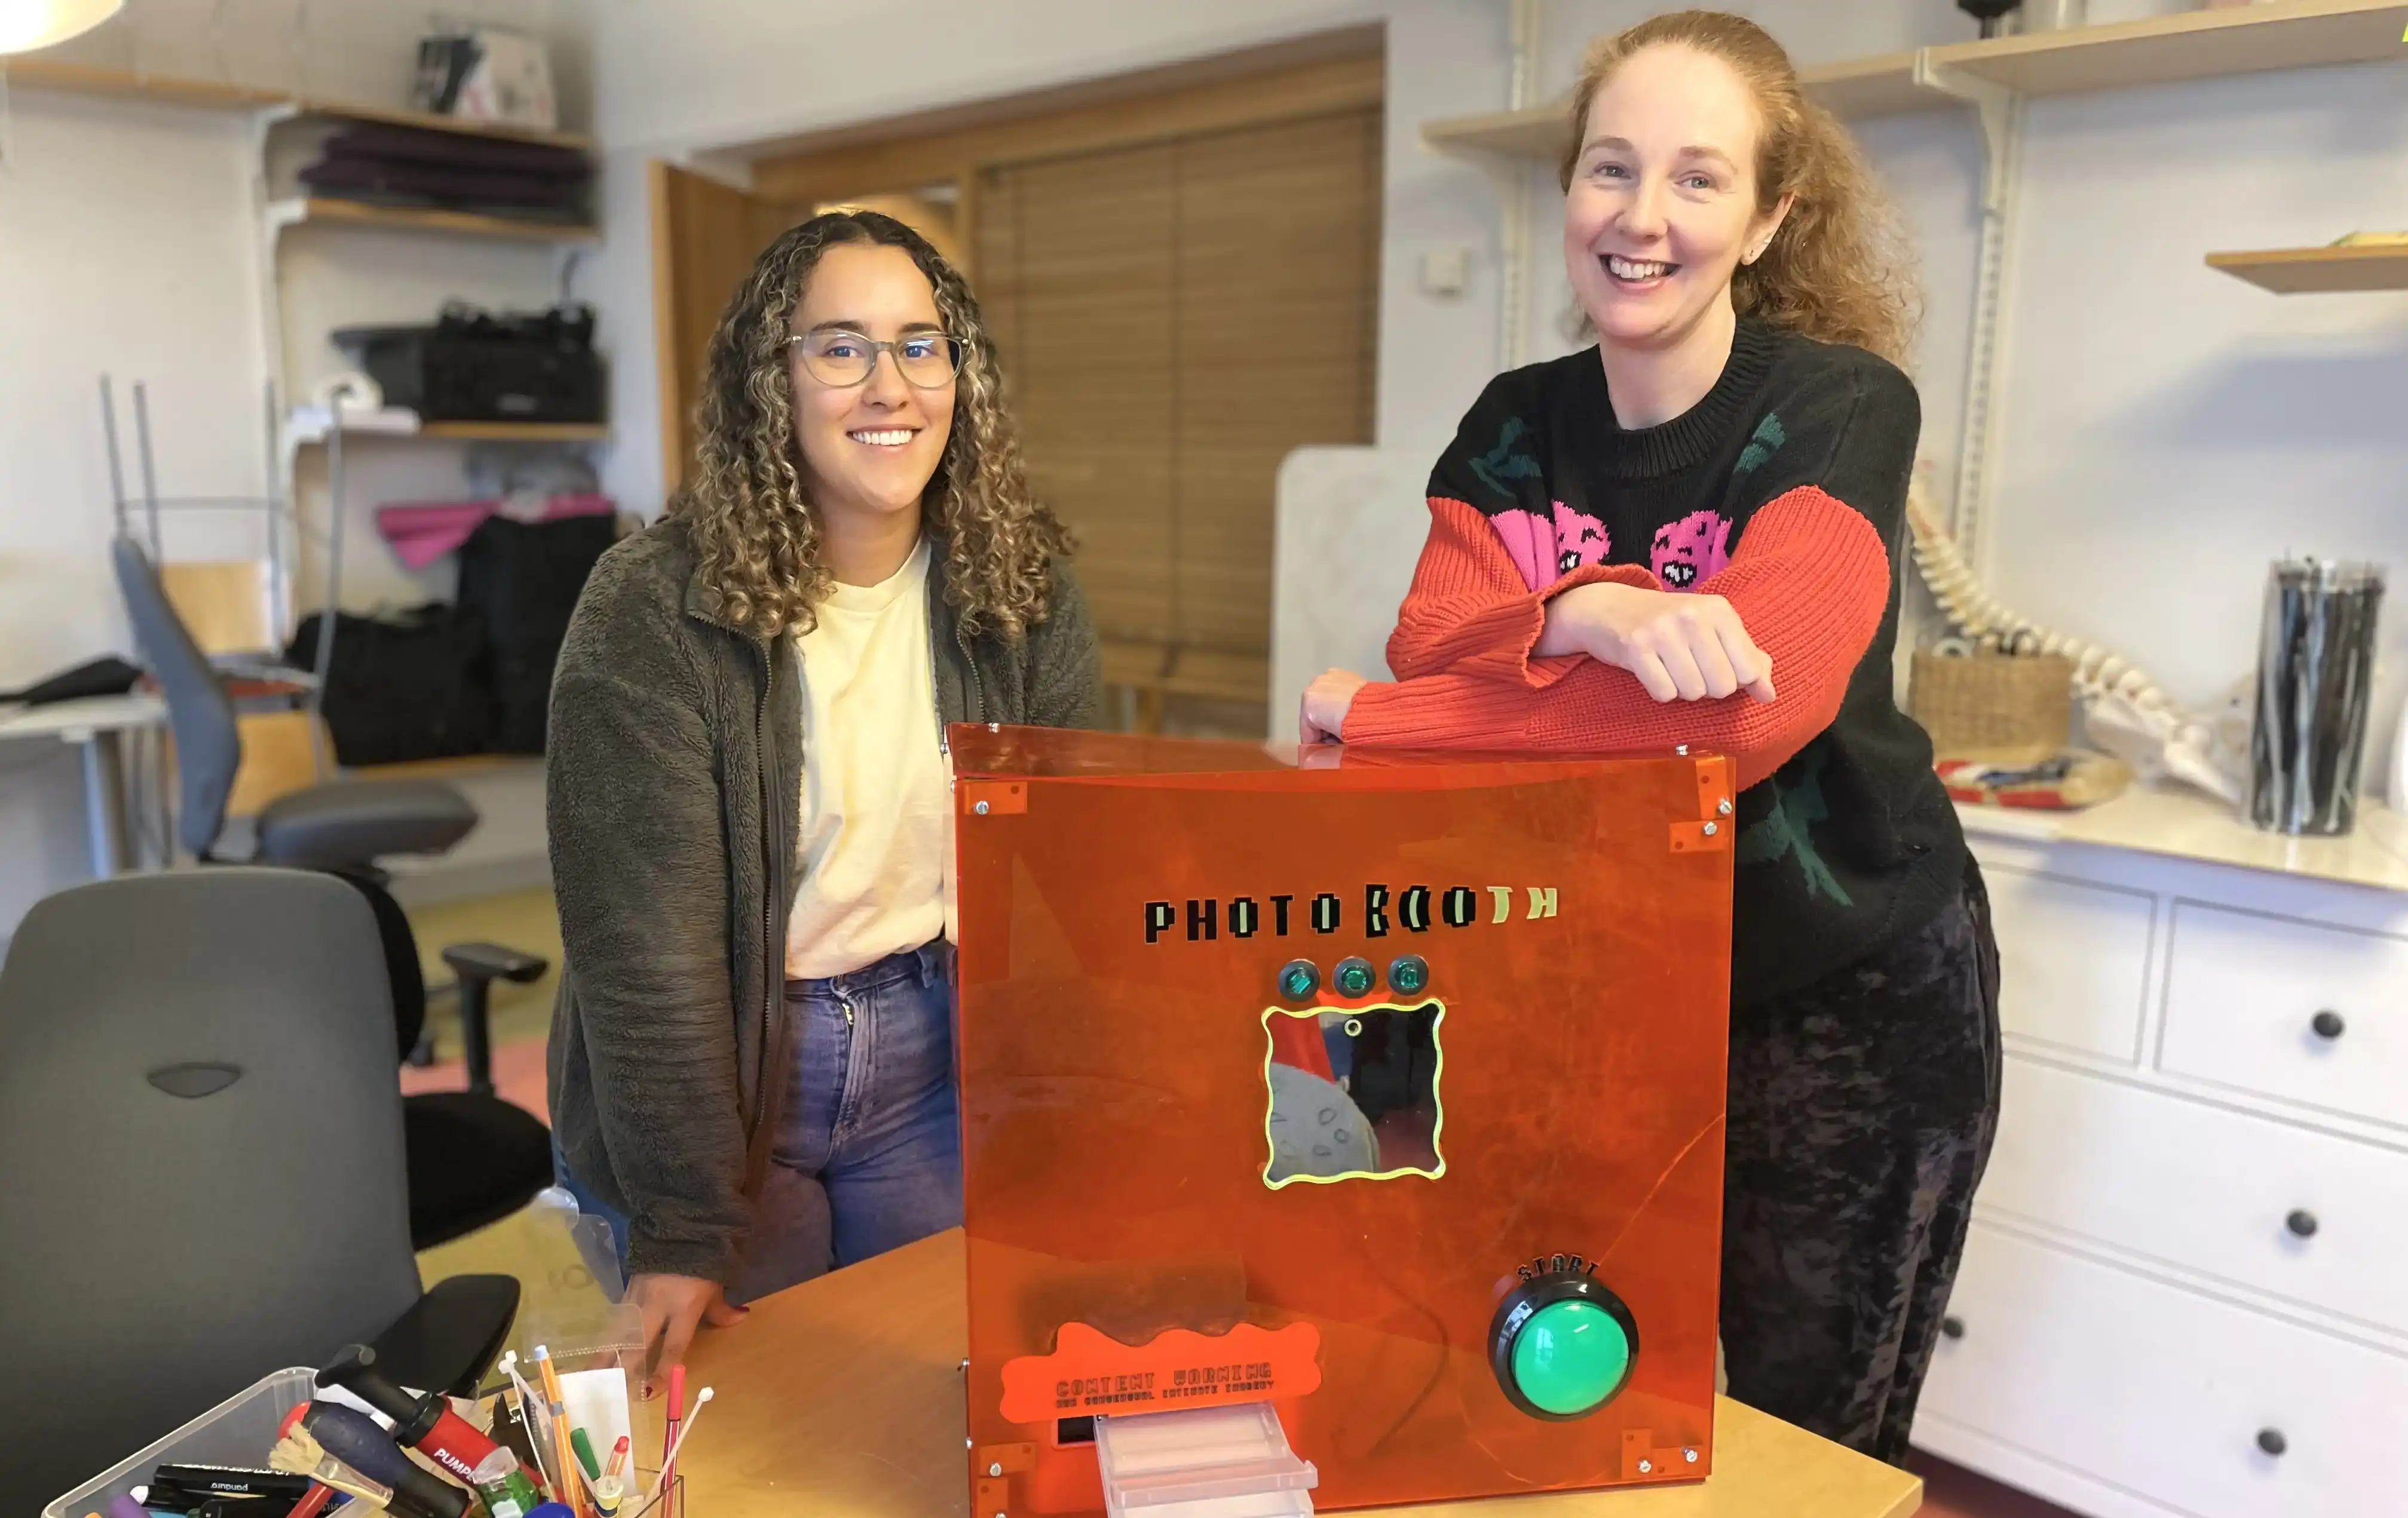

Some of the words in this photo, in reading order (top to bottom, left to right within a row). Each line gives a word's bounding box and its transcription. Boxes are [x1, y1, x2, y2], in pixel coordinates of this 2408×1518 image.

[1145, 893, 1340, 944] PHOTO
[1365, 884, 1557, 938] BOOTH
[1516, 1253, 1600, 1282] START
[1056, 1372, 1154, 1397] CONTENT
[1174, 1362, 1272, 1385] WARNING
[211, 1482, 248, 1491] panduro
